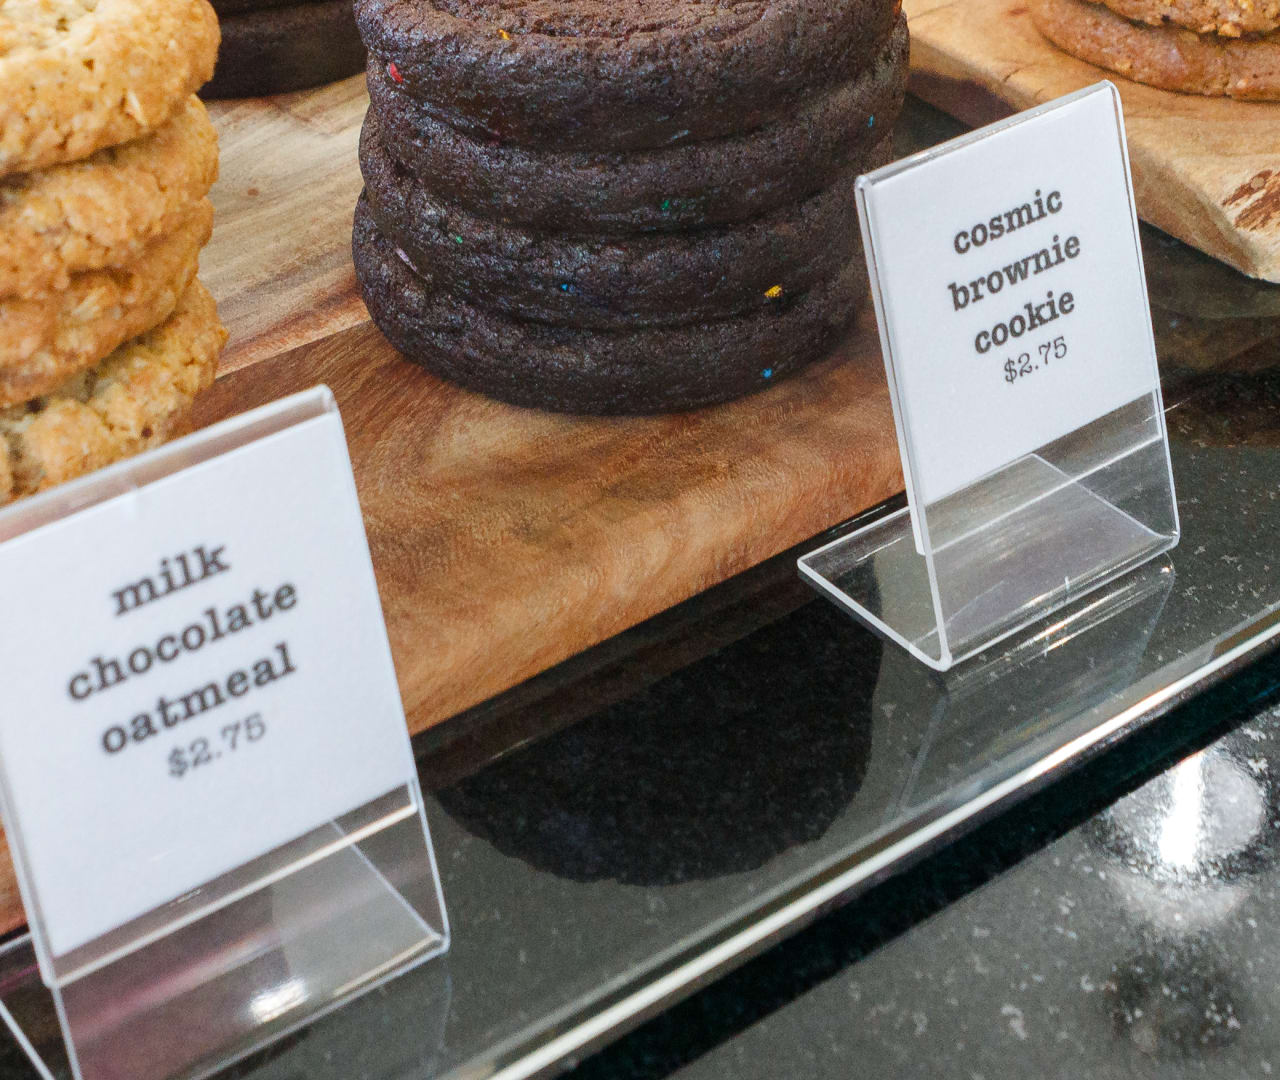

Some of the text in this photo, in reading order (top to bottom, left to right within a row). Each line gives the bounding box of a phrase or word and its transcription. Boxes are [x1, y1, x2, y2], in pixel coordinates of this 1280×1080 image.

[954, 189, 1063, 255] cosmic
[948, 233, 1081, 311] brownie
[974, 289, 1075, 354] cookie
[1004, 336, 1068, 384] $2.75
[110, 544, 231, 617] milk
[67, 580, 299, 703] chocolate
[100, 643, 297, 755] oatmeal
[167, 713, 266, 779] $2.75
